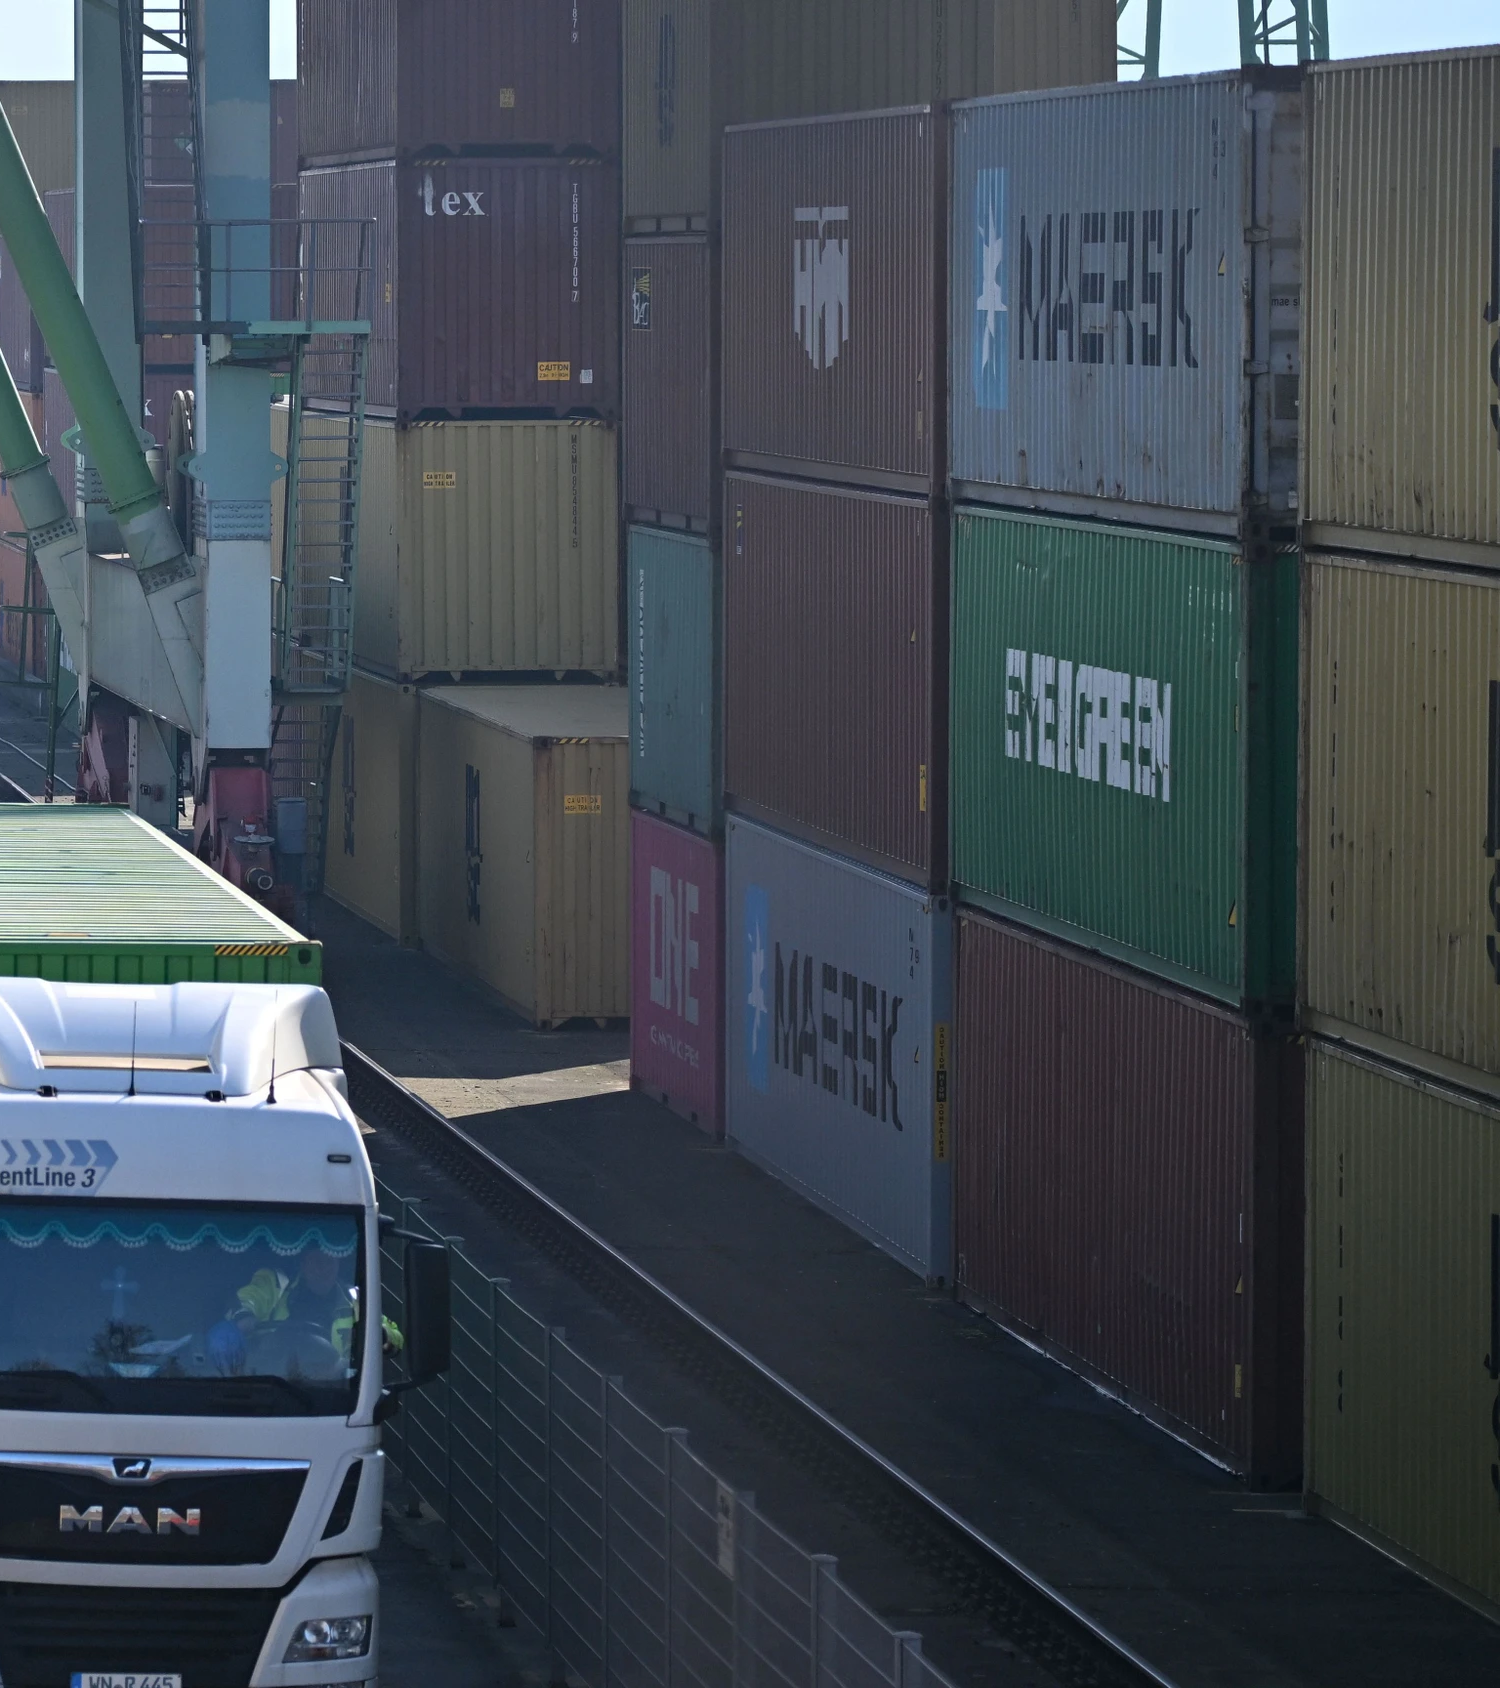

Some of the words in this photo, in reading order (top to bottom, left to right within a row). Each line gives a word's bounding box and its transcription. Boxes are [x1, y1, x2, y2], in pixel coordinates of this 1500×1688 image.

[1018, 207, 1200, 369] MAERSK
[539, 363, 569, 372] CAUTION
[650, 865, 699, 1026] ONE
[774, 942, 903, 1132] MAERSK
[81, 1168, 96, 1188] 3
[59, 1504, 201, 1534] MAN
[88, 1676, 113, 1688] WN
